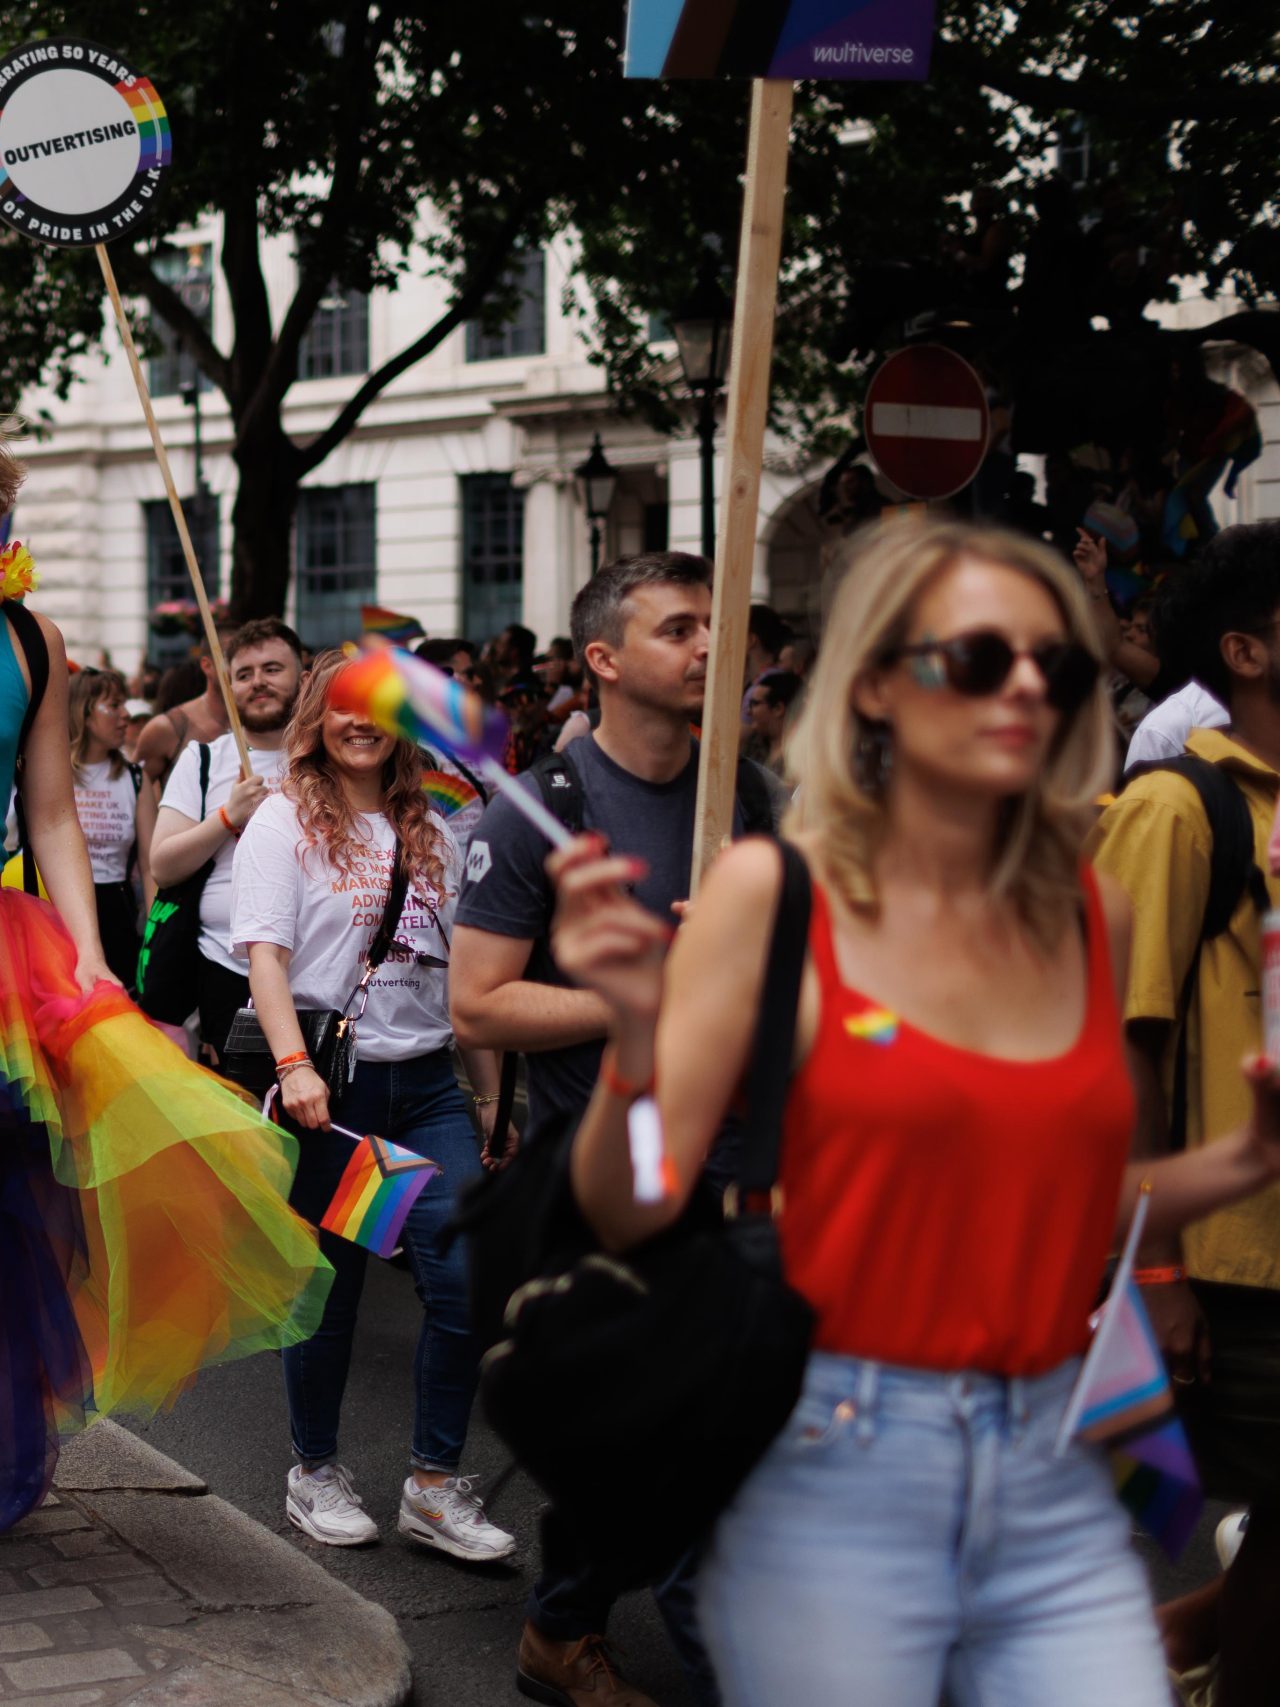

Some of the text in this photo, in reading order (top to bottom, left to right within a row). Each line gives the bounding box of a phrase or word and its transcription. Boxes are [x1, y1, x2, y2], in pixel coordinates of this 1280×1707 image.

[62, 45, 84, 60] 50
[88, 50, 136, 88] YEARS
[813, 42, 914, 64] multiverse
[4, 119, 136, 166] OUTVERTISING
[2, 161, 162, 241] OF PRIDE IN THE U.K.
[352, 913, 437, 930] COMTELY
